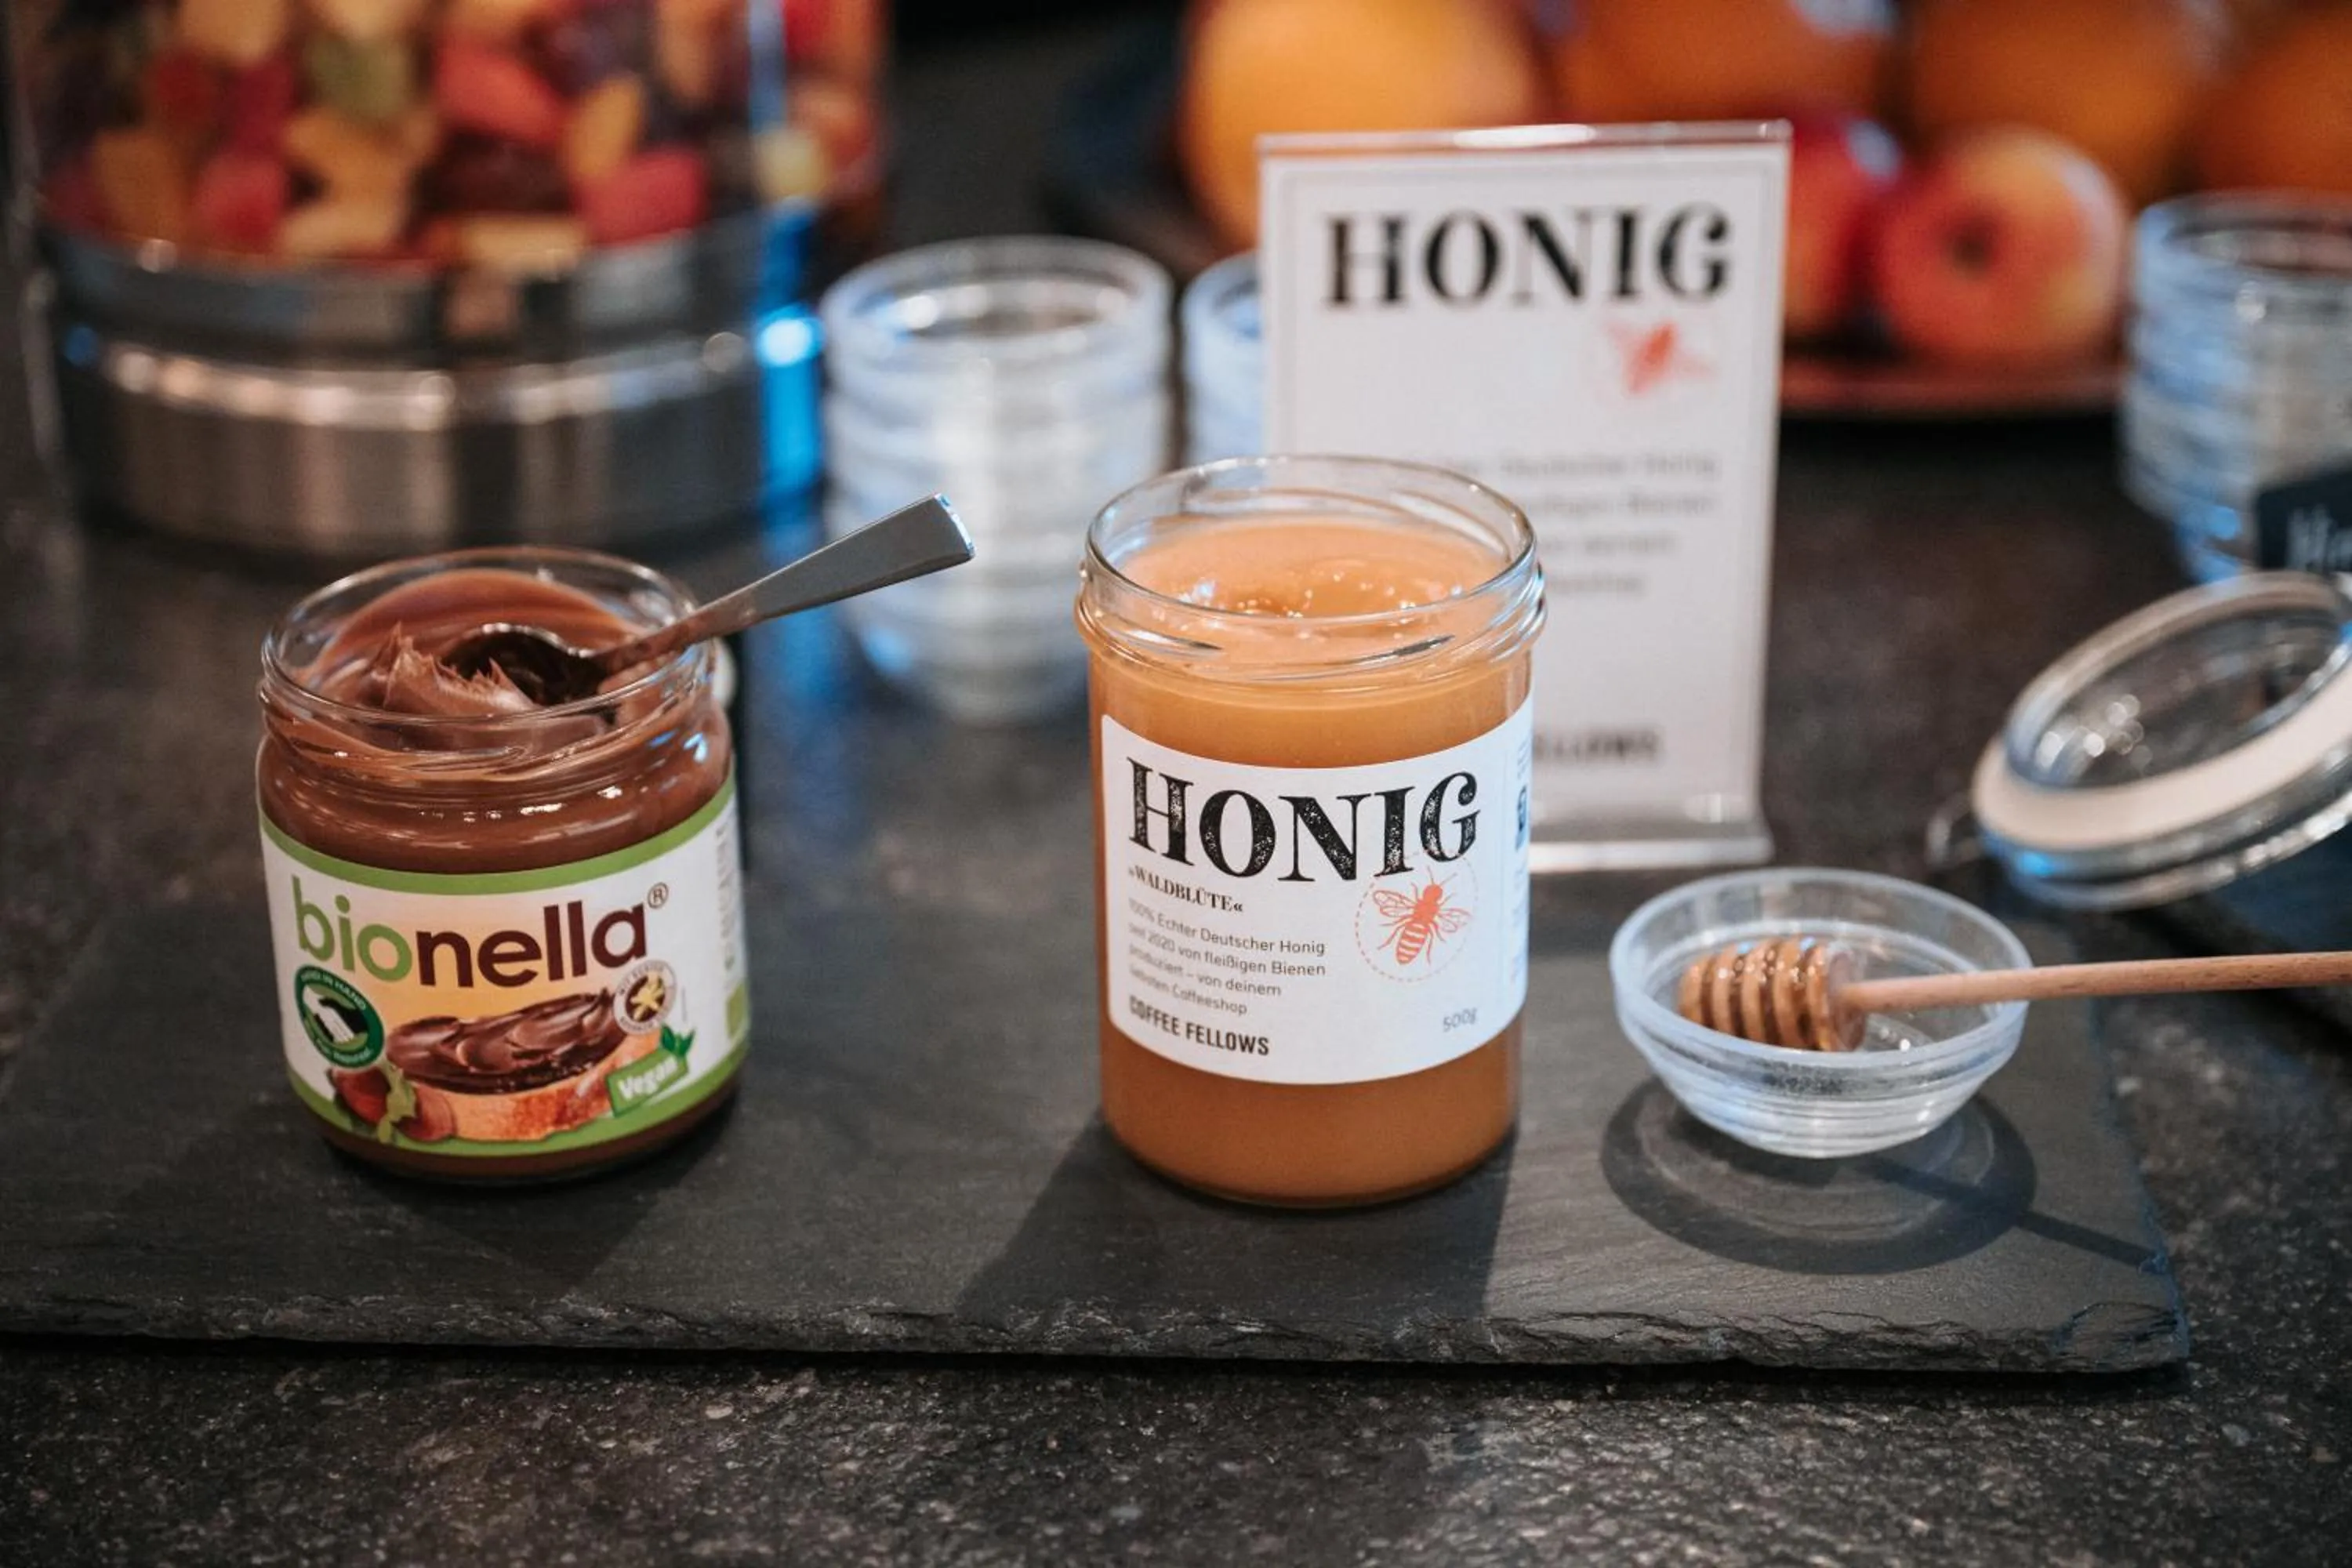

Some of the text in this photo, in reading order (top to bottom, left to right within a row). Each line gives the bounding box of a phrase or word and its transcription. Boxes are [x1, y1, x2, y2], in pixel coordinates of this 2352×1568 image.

[1323, 202, 1733, 308] HONIG
[1127, 757, 1480, 881] HONIG
[1157, 913, 1196, 938] Echter
[1200, 927, 1275, 952] Deutscher
[1279, 940, 1326, 957] Honig
[1178, 946, 1201, 961] von
[1204, 949, 1266, 975] fleißigen
[1271, 960, 1326, 976] Bienen
[1172, 983, 1248, 1016] Coffeeshop
[1197, 972, 1221, 988] von
[1225, 978, 1282, 996] deinem
[1129, 994, 1270, 1056] COFFEE FELLOWS
